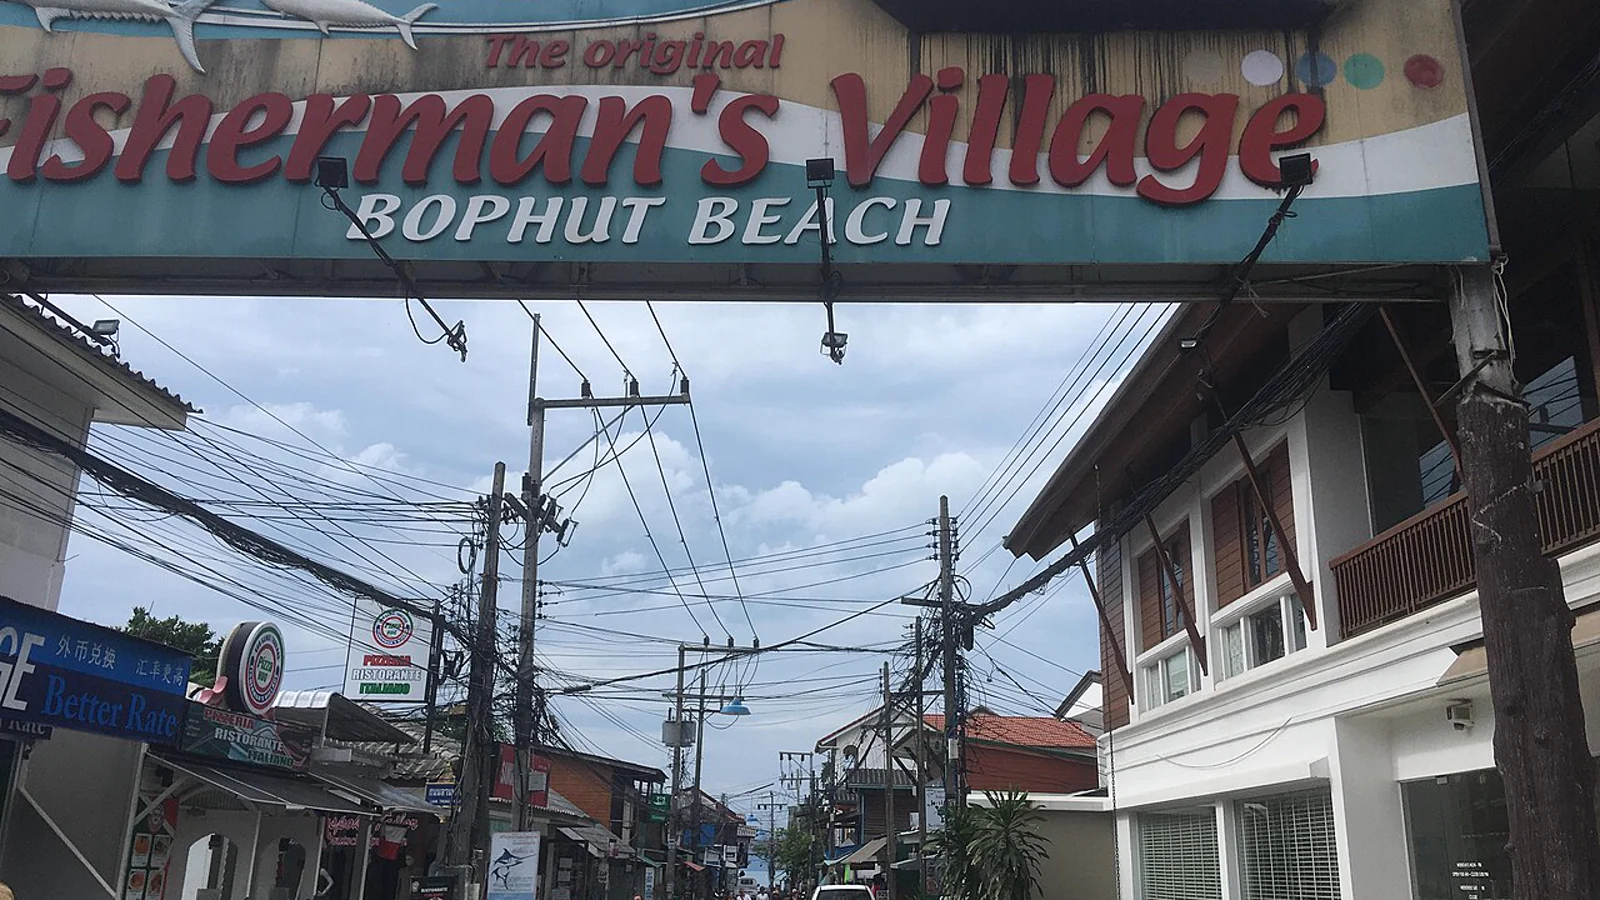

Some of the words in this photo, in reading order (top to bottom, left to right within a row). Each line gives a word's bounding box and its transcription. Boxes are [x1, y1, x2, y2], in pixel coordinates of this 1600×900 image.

[485, 32, 568, 69] The
[584, 33, 785, 76] original
[829, 66, 1325, 207] Village
[346, 193, 666, 246] BOPHUT
[688, 195, 952, 247] BEACH
[55, 635, 117, 670] 外币兑换
[352, 669, 422, 681] RISTORANTE
[40, 674, 123, 729] Better
[125, 692, 179, 737] Rate
[204, 708, 255, 730] PIZZERIA
[214, 727, 284, 752] RISTORANTE
[247, 749, 294, 766] ITALIANO
